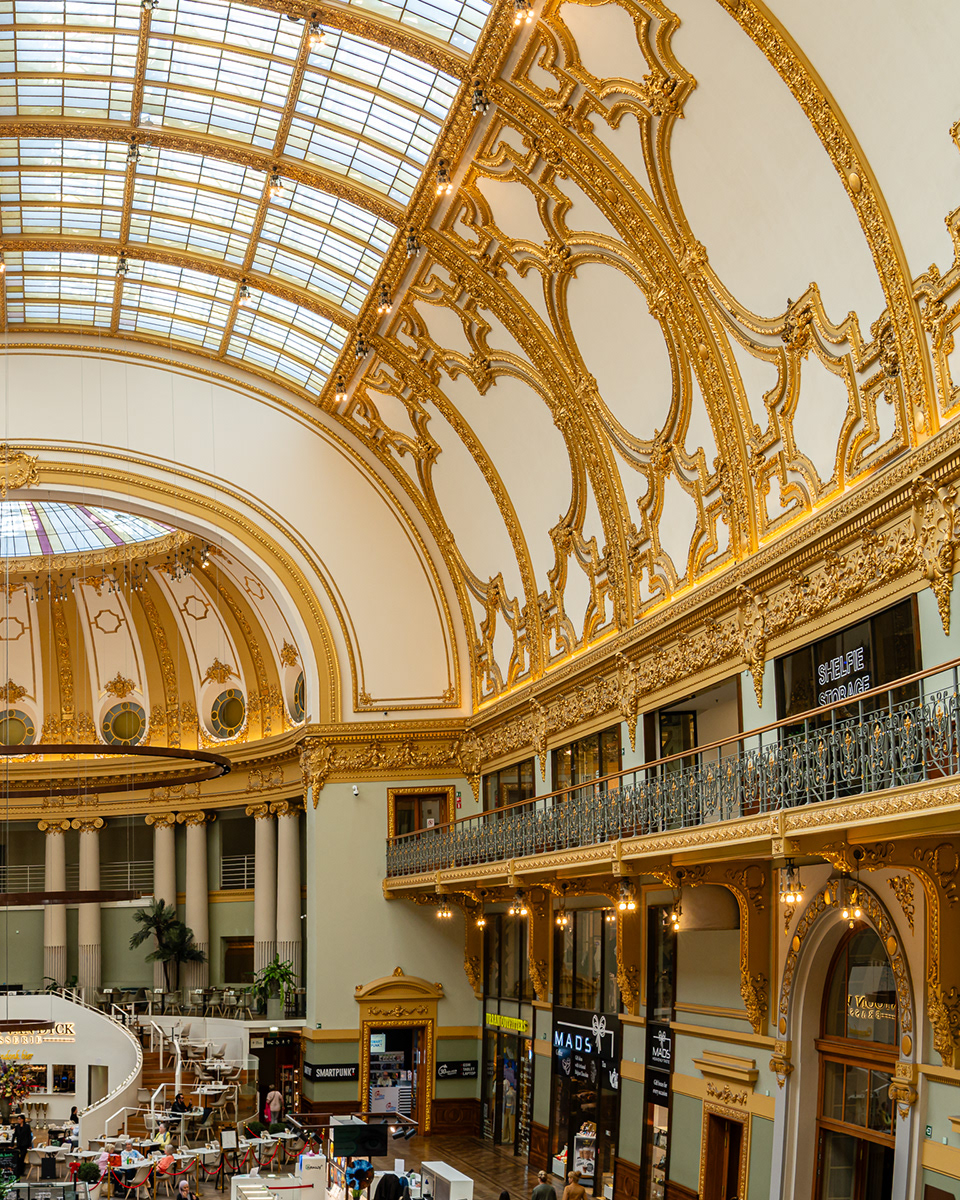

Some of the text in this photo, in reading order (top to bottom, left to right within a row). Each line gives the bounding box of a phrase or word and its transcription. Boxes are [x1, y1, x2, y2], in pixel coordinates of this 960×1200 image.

[818, 647, 865, 686] SHELFIE
[818, 675, 870, 706] STORAGE
[554, 1030, 592, 1053] MADS
[652, 1046, 671, 1059] MADS
[315, 1068, 355, 1078] SMARTPUNKT
